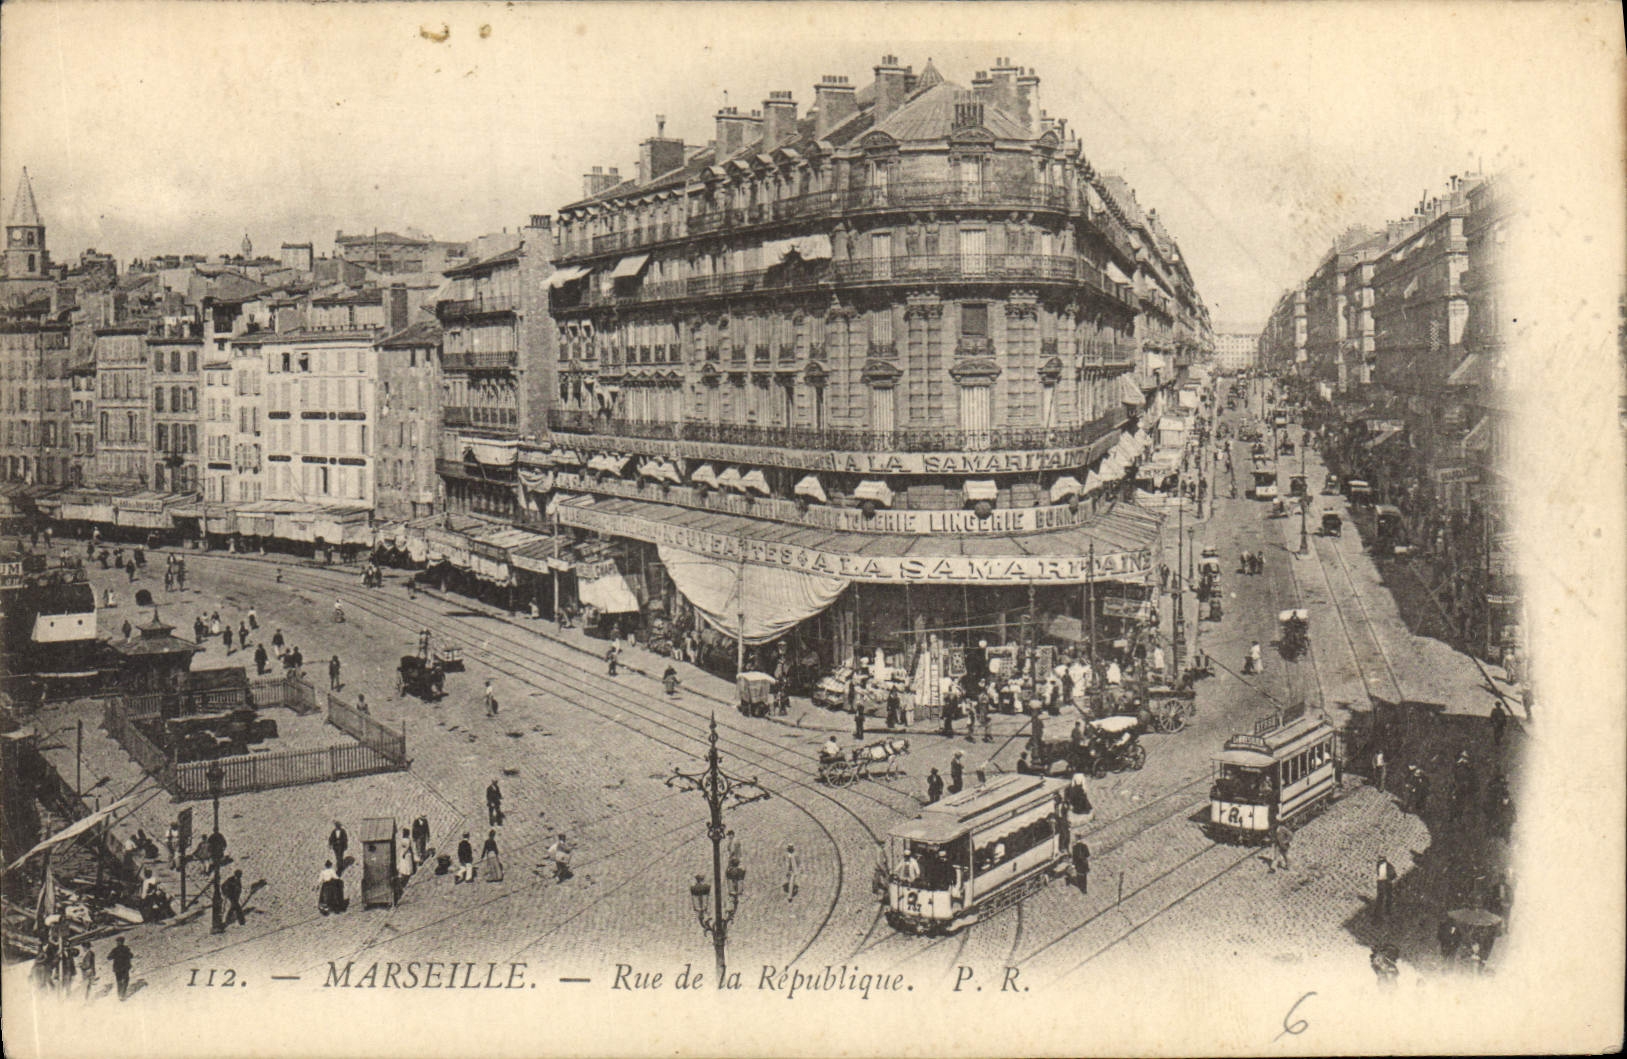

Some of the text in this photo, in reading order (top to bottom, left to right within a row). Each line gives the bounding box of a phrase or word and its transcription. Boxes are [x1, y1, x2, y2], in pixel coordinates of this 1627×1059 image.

[845, 454, 863, 472] A
[868, 454, 912, 473] LA
[929, 511, 1026, 532] LINGERIE
[811, 553, 835, 574] A
[838, 556, 893, 578] LA
